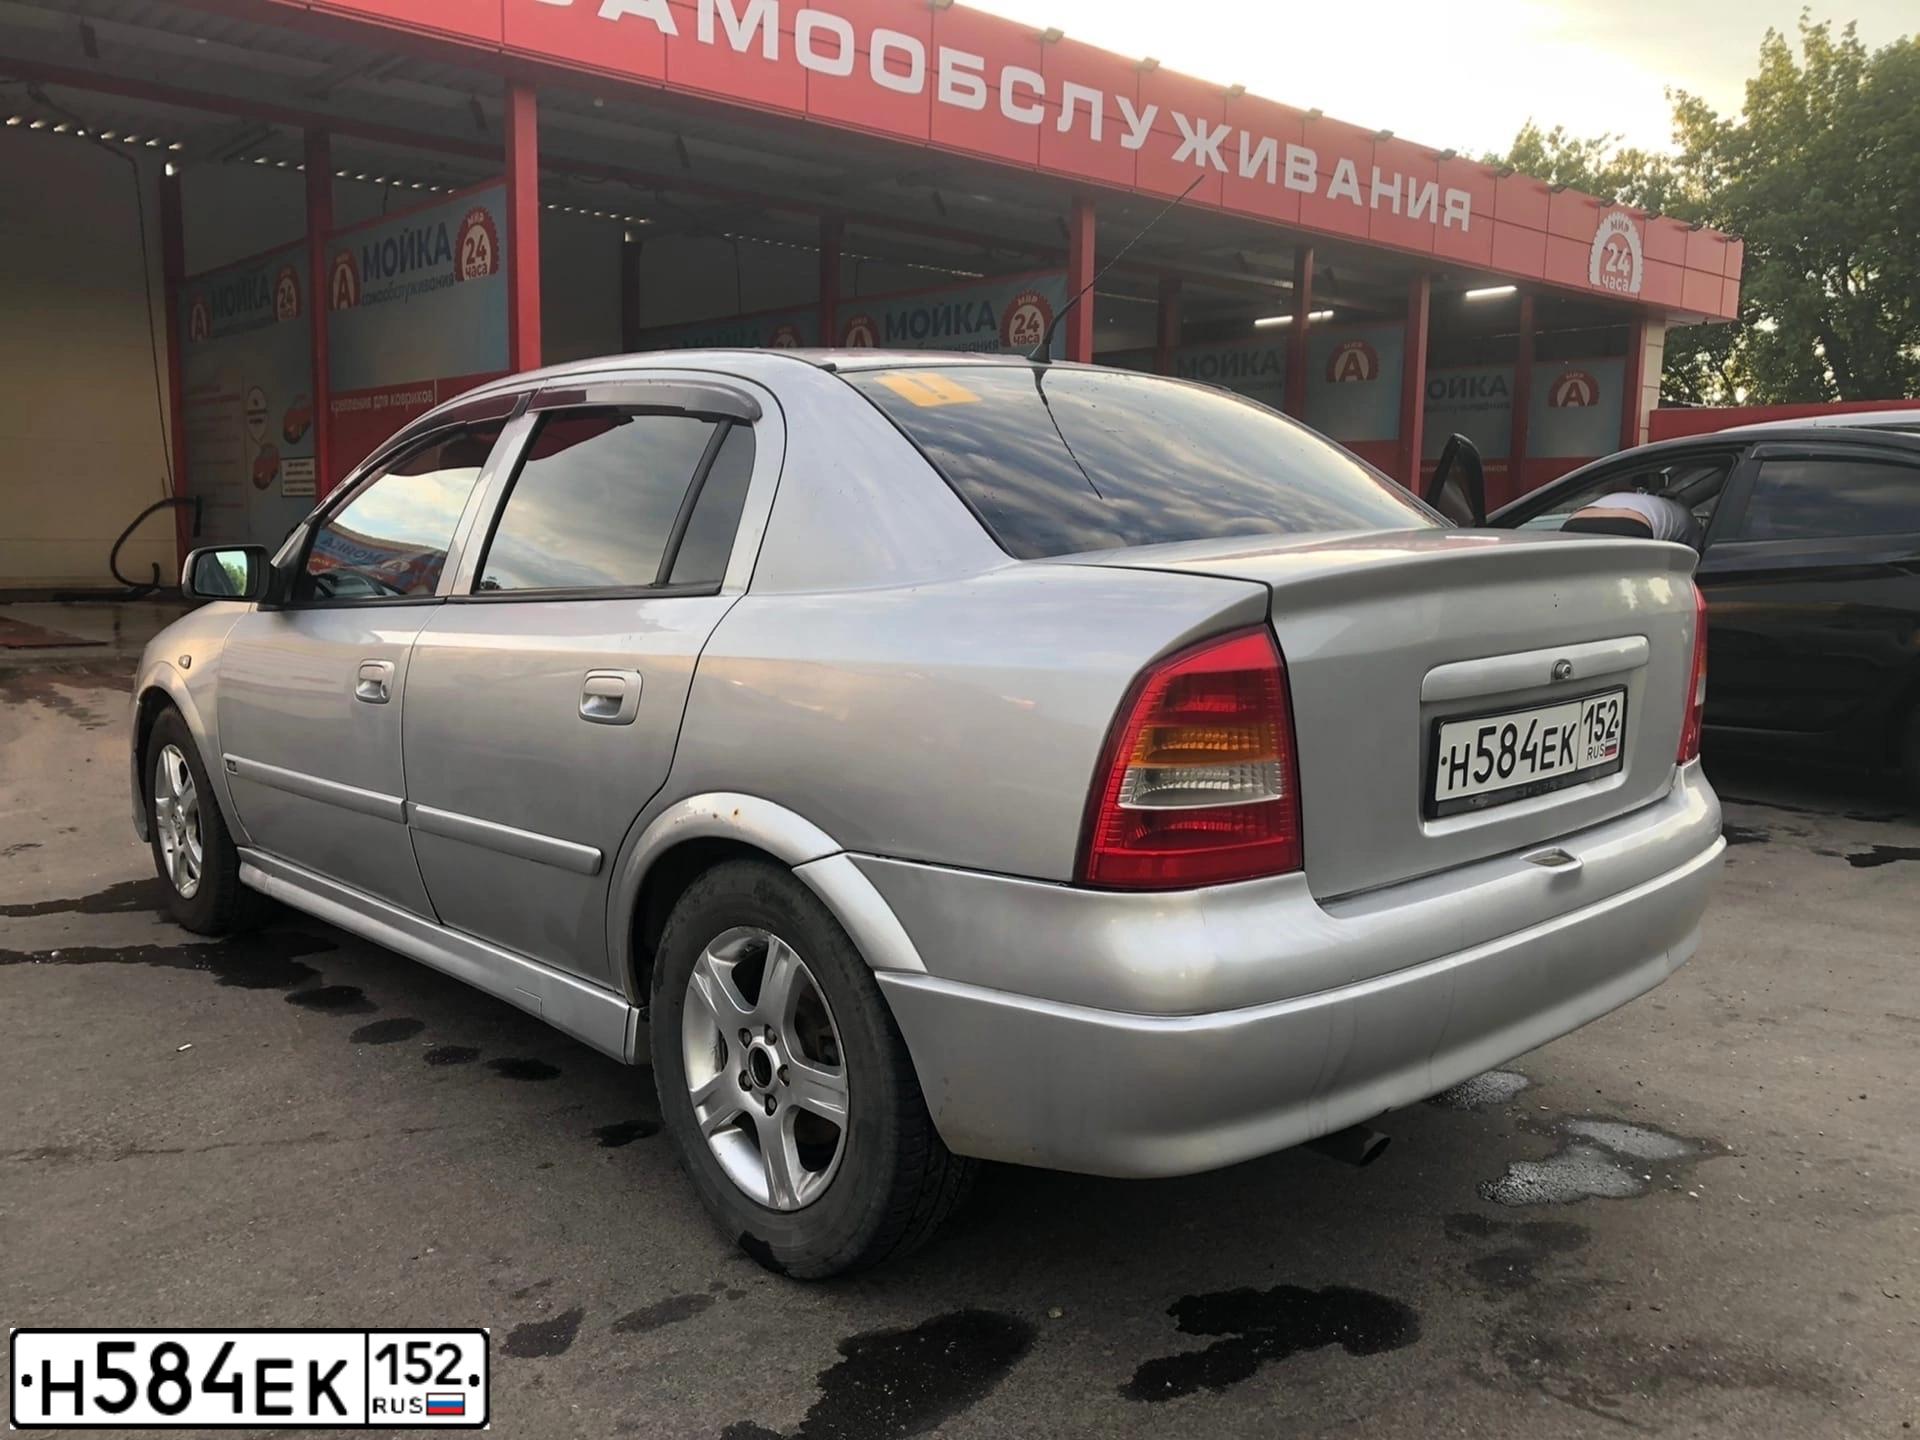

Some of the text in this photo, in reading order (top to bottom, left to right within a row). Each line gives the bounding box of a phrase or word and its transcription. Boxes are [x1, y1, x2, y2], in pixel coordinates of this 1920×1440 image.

[534, 0, 1471, 233] МООБСЛУЖИВАНИЯ
[362, 221, 452, 282] МОЙКА
[465, 234, 487, 266] 24
[1606, 242, 1631, 276] 24
[466, 262, 488, 278] часа
[1601, 274, 1630, 293] часа
[884, 300, 997, 342] МОЙКА
[1013, 313, 1039, 334] 24
[1012, 332, 1039, 346] часа
[1176, 348, 1281, 379] МОЙКА
[1339, 352, 1367, 382] А
[1427, 373, 1507, 401] ОЙКА
[1562, 382, 1589, 407] А
[1447, 699, 1618, 790] Н584ЕК 152
[1586, 745, 1605, 760] RUS
